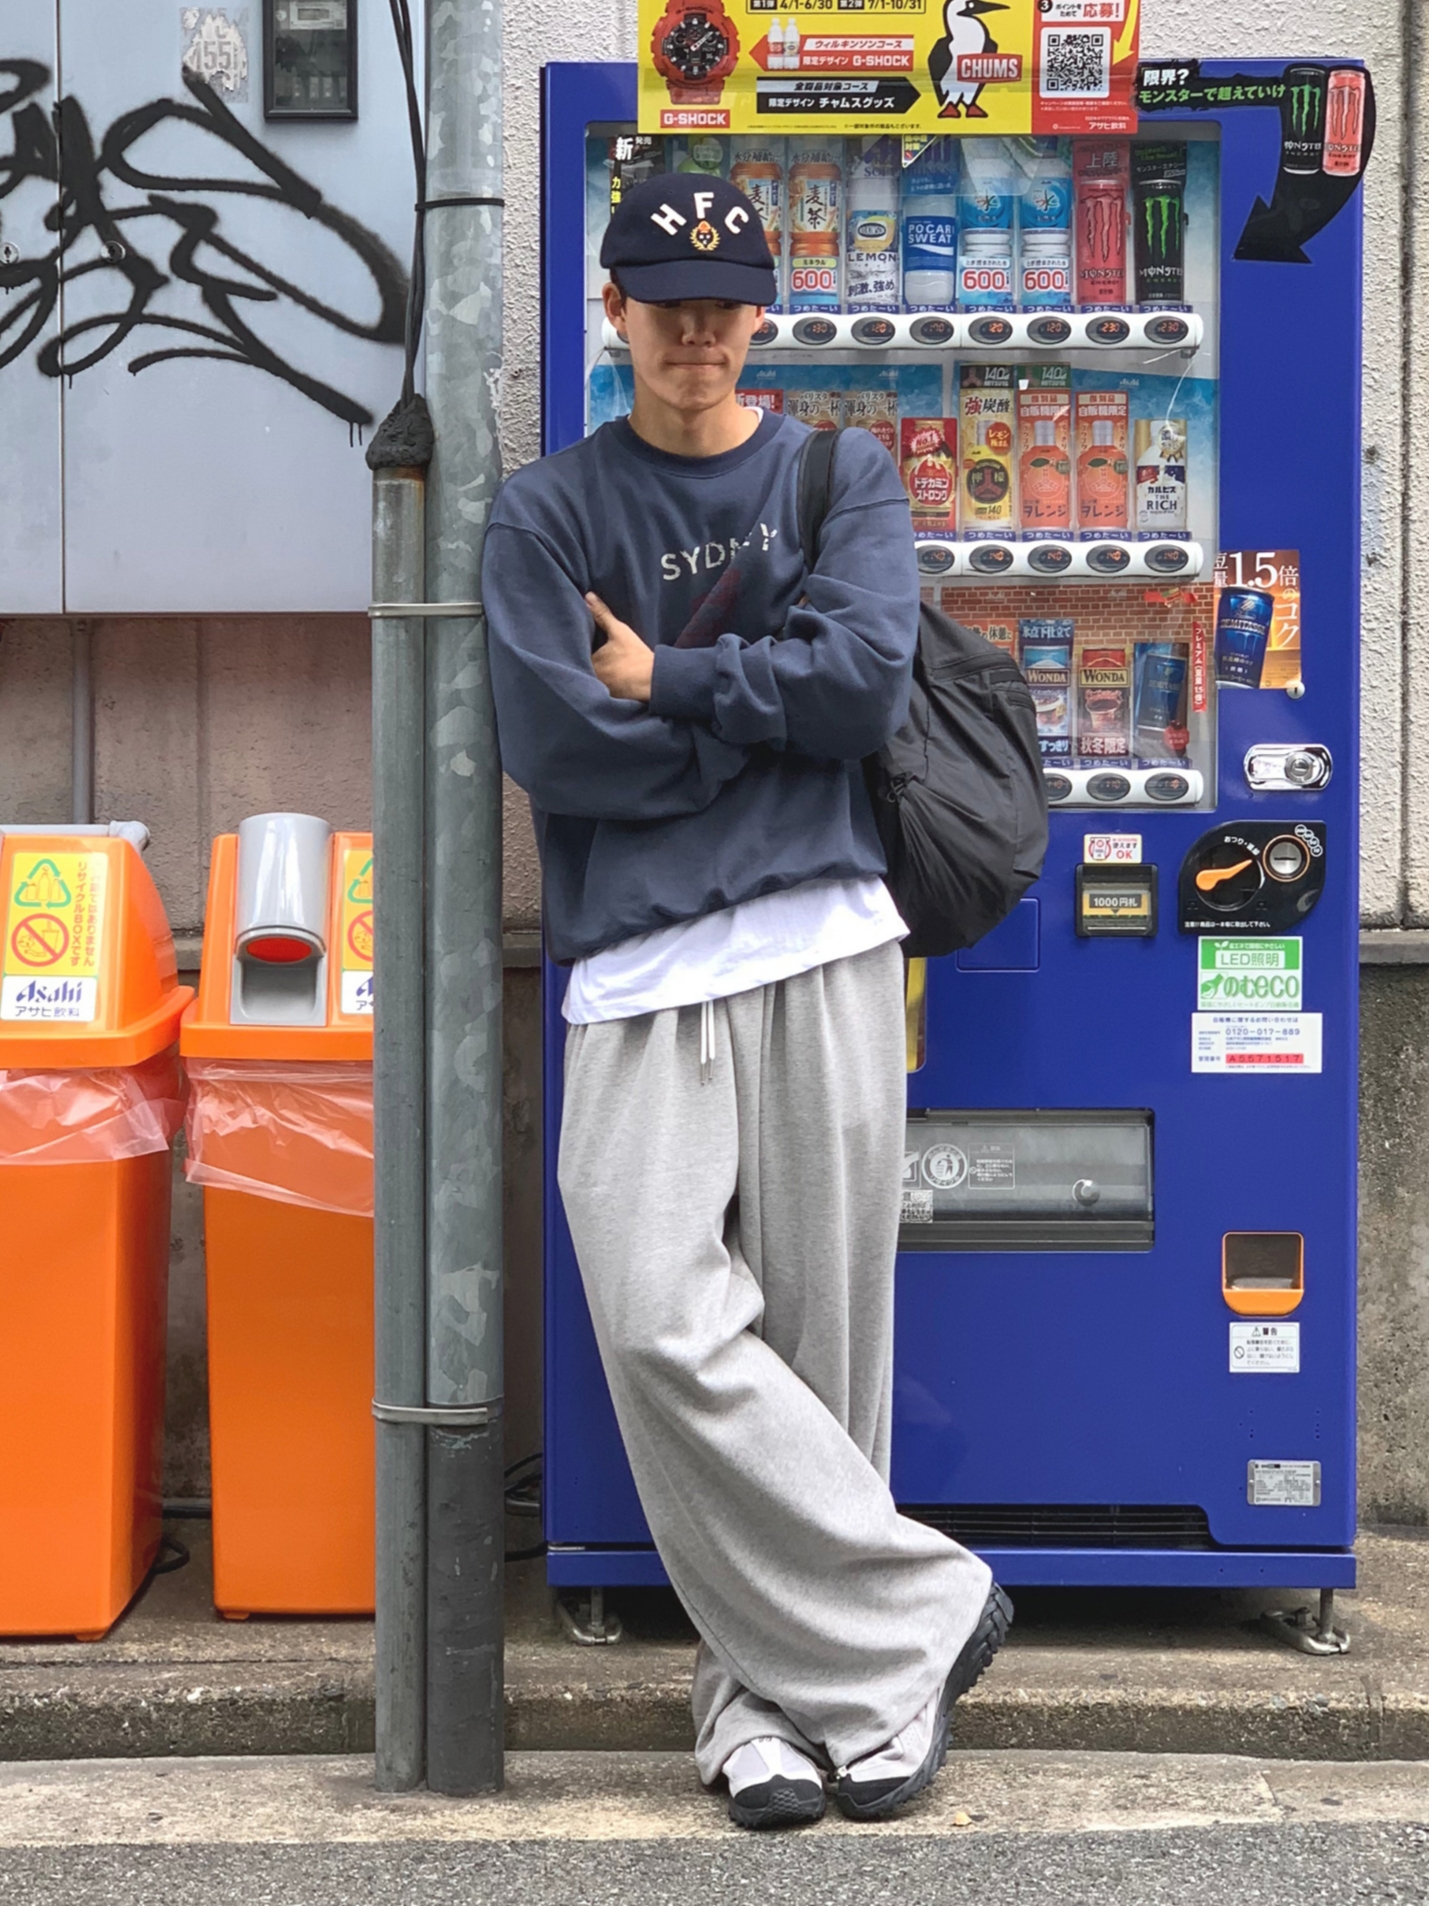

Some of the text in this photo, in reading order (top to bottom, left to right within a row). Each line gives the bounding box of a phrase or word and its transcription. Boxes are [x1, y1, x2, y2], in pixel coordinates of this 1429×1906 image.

[1083, 2, 1121, 19] 応募!
[815, 40, 902, 49] ウィルキンソンコース
[803, 55, 910, 66] 限定デザイン G-SHOCK
[961, 58, 1019, 79] CHUMS
[1143, 69, 1190, 86] 限界?
[1138, 84, 1286, 104] モンスターで超えていけ
[768, 97, 896, 108] 限定デザイン チャムスグッズ
[663, 113, 727, 125] G-SHOCK
[1089, 122, 1126, 130] アサヒ飲料
[1086, 151, 1118, 168] 上陸
[805, 185, 826, 229] 麦茶
[908, 234, 952, 244] SWEAT
[848, 253, 897, 264] LEMON
[792, 269, 832, 290] 600
[963, 270, 1005, 290] 600
[1024, 270, 1065, 290] 600
[965, 396, 1010, 416] 強炭酸
[1078, 405, 1126, 417] 自販機限定
[988, 429, 1009, 439] レモン
[914, 477, 949, 488] ドデカミン
[916, 490, 947, 500] ストロング
[1148, 486, 1176, 494] カルピス
[1146, 500, 1178, 510] RICH
[660, 522, 778, 581] SYDY
[1229, 551, 1278, 588] 1.5
[1022, 626, 1071, 638] 氷点下仕立て
[1028, 669, 1067, 683] WONDA
[1083, 669, 1125, 683] WONDA
[1080, 738, 1127, 754] 秋冬限定
[1116, 850, 1132, 859] OK
[1093, 898, 1138, 907] 1000円札
[83, 863, 100, 966] 箱ではありません
[1221, 953, 1279, 967] LED照明
[16, 980, 83, 1003] Asahi
[1223, 975, 1300, 999] のむeco
[15, 1005, 80, 1017] アサヒ飲料
[1225, 1028, 1300, 1036] 0120-017-889
